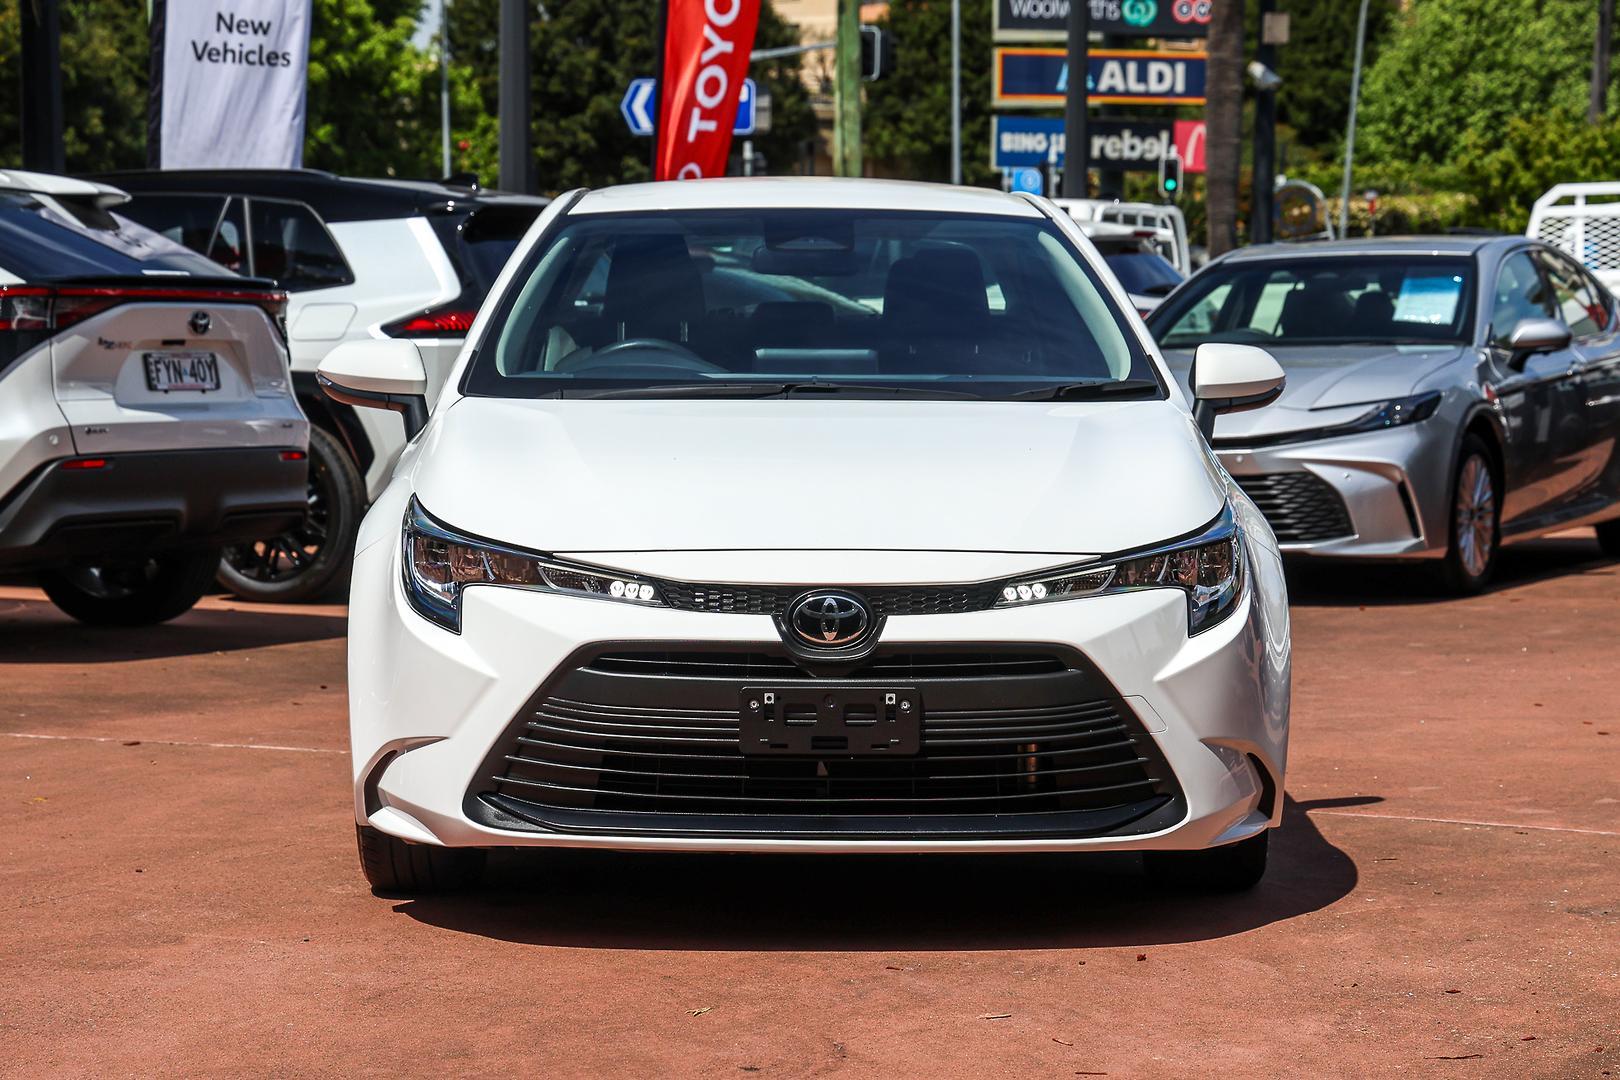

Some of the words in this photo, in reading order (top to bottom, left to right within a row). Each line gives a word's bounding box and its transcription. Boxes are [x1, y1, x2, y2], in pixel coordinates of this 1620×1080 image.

[216, 12, 271, 36] New
[191, 40, 291, 68] Vehicles
[1098, 60, 1186, 94] ALDI
[1091, 129, 1170, 160] rebel
